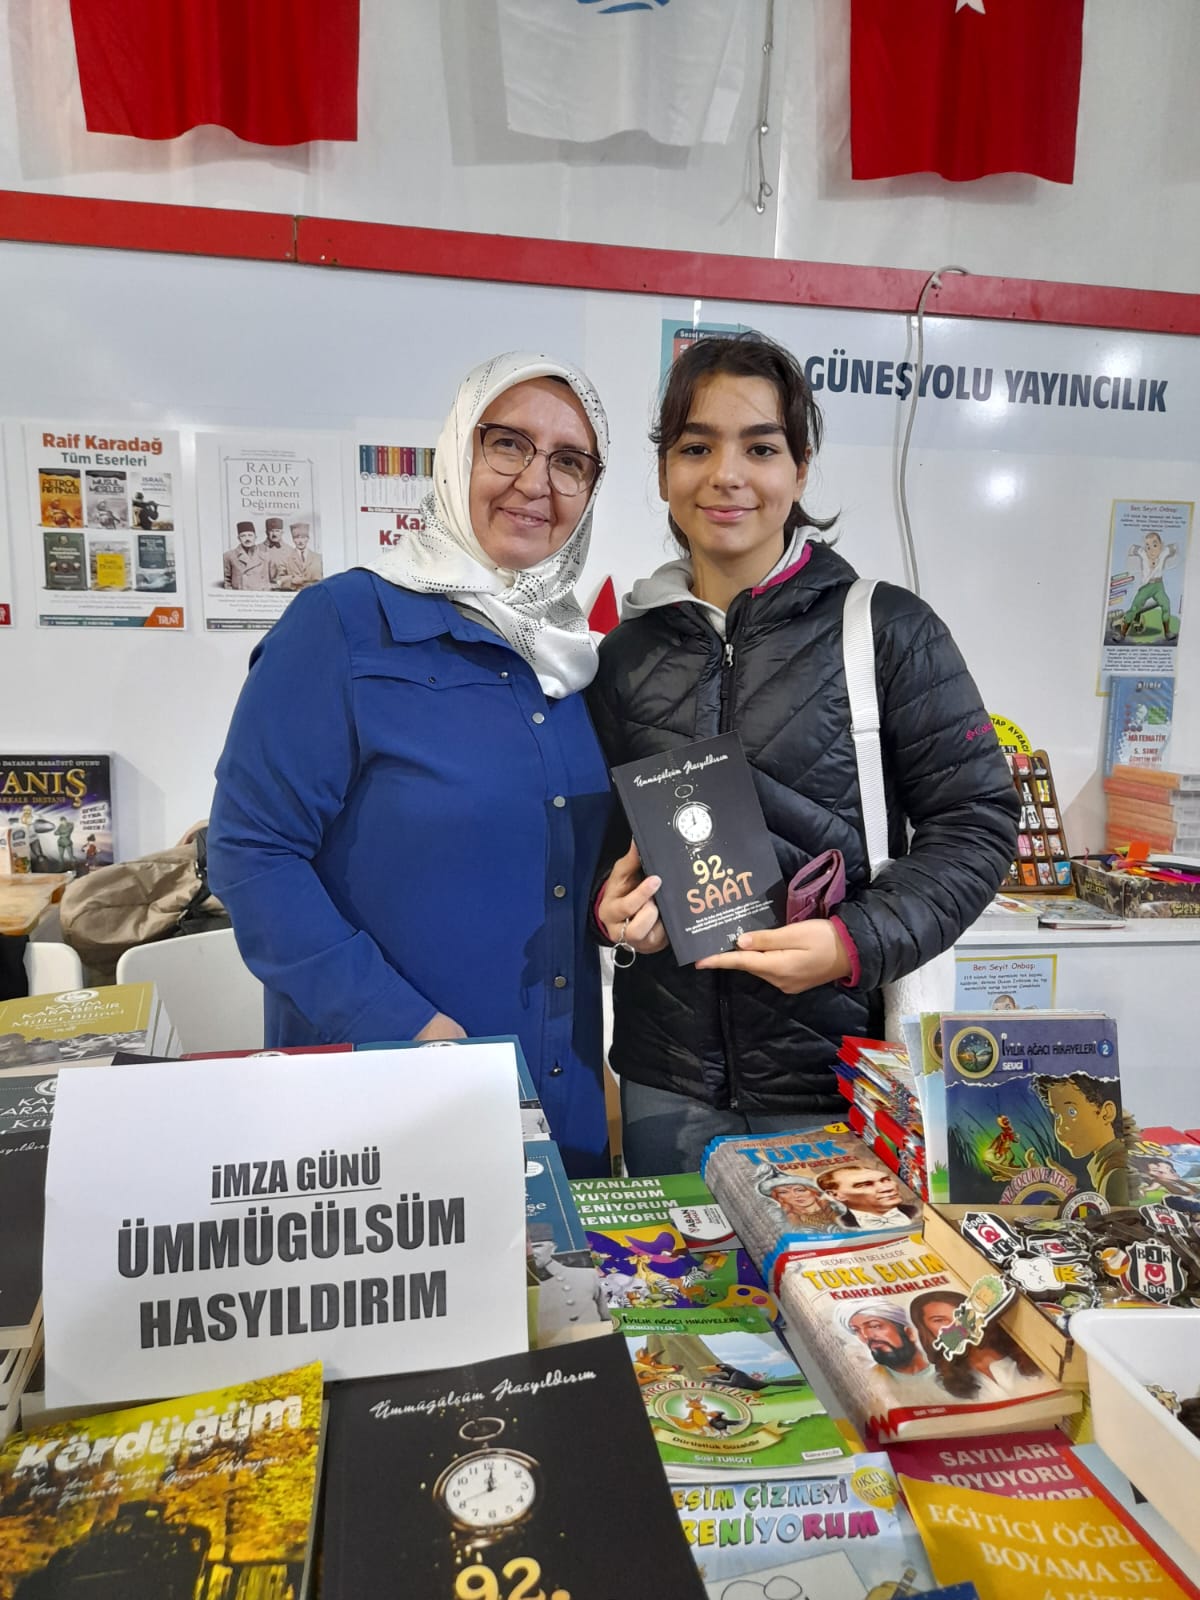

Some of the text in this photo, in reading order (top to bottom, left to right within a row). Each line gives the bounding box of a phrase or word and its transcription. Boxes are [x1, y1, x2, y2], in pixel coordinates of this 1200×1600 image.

[805, 349, 1168, 412] GÜNEŞYOLU YAYINCILIK
[42, 433, 163, 455] Raif Karadağ
[61, 452, 147, 467] Tüm Eserleri
[246, 462, 293, 474] RAUF
[239, 474, 299, 487] ORBAY
[240, 486, 300, 499] Cehennem
[241, 498, 300, 511] Değirmeni
[692, 854, 735, 885] 92.
[686, 871, 754, 915] SAAT
[973, 963, 987, 971] Ben
[737, 1140, 848, 1165] TÜRK
[211, 1146, 381, 1199] İMZA GÜNÜ
[569, 1179, 661, 1192] YVANLARI
[572, 1189, 665, 1202] YUYORUM
[577, 1199, 678, 1214] ENİYORUM
[118, 1192, 466, 1278] ÜMMÜGÜLSÜM
[1137, 1248, 1172, 1263] BJK
[802, 1252, 949, 1291] TÜRK BİLİM
[140, 1270, 448, 1349] HASYILDIRIM
[940, 1442, 1060, 1468] SAYILARI
[743, 1477, 849, 1510] ÇİZMEYİ
[927, 1503, 1048, 1546] EĞİTİCİ
[978, 1541, 1118, 1584] BOYAMA
